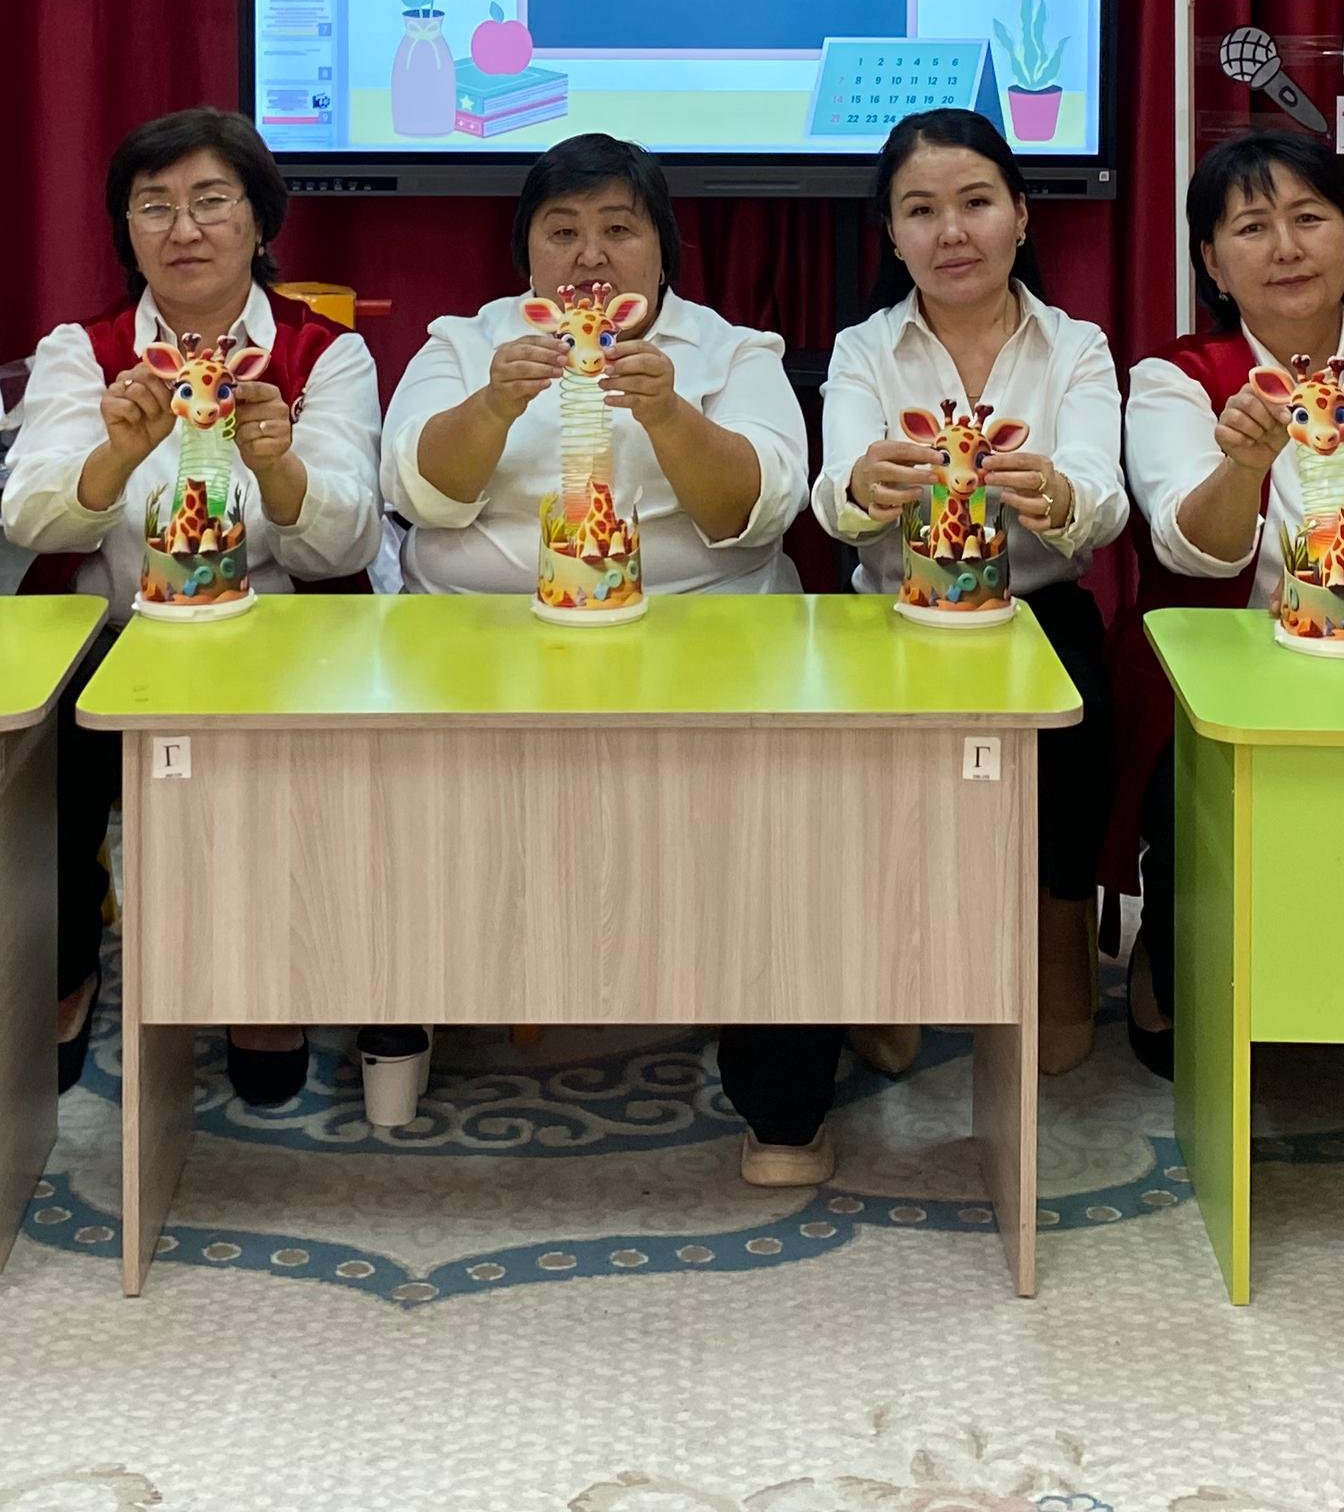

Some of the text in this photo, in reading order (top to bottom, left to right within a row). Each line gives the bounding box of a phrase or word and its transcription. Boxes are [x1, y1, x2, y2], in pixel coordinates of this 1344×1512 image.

[858, 57, 959, 67] 1 2 3 4 5 6
[855, 76, 862, 85] 8
[875, 76, 882, 85] 9
[891, 76, 902, 85] 10
[910, 76, 919, 85] 11
[927, 76, 938, 85] 12
[947, 76, 958, 85] 13
[850, 95, 862, 104] 15
[870, 95, 880, 104] 16
[889, 95, 899, 104] 17
[906, 95, 916, 104] 18
[924, 95, 935, 104] 19
[941, 95, 954, 104] 20
[847, 114, 859, 124] 22
[865, 114, 878, 124] 23
[883, 114, 896, 124] 24
[162, 744, 181, 768] Г
[973, 744, 991, 768] Г
